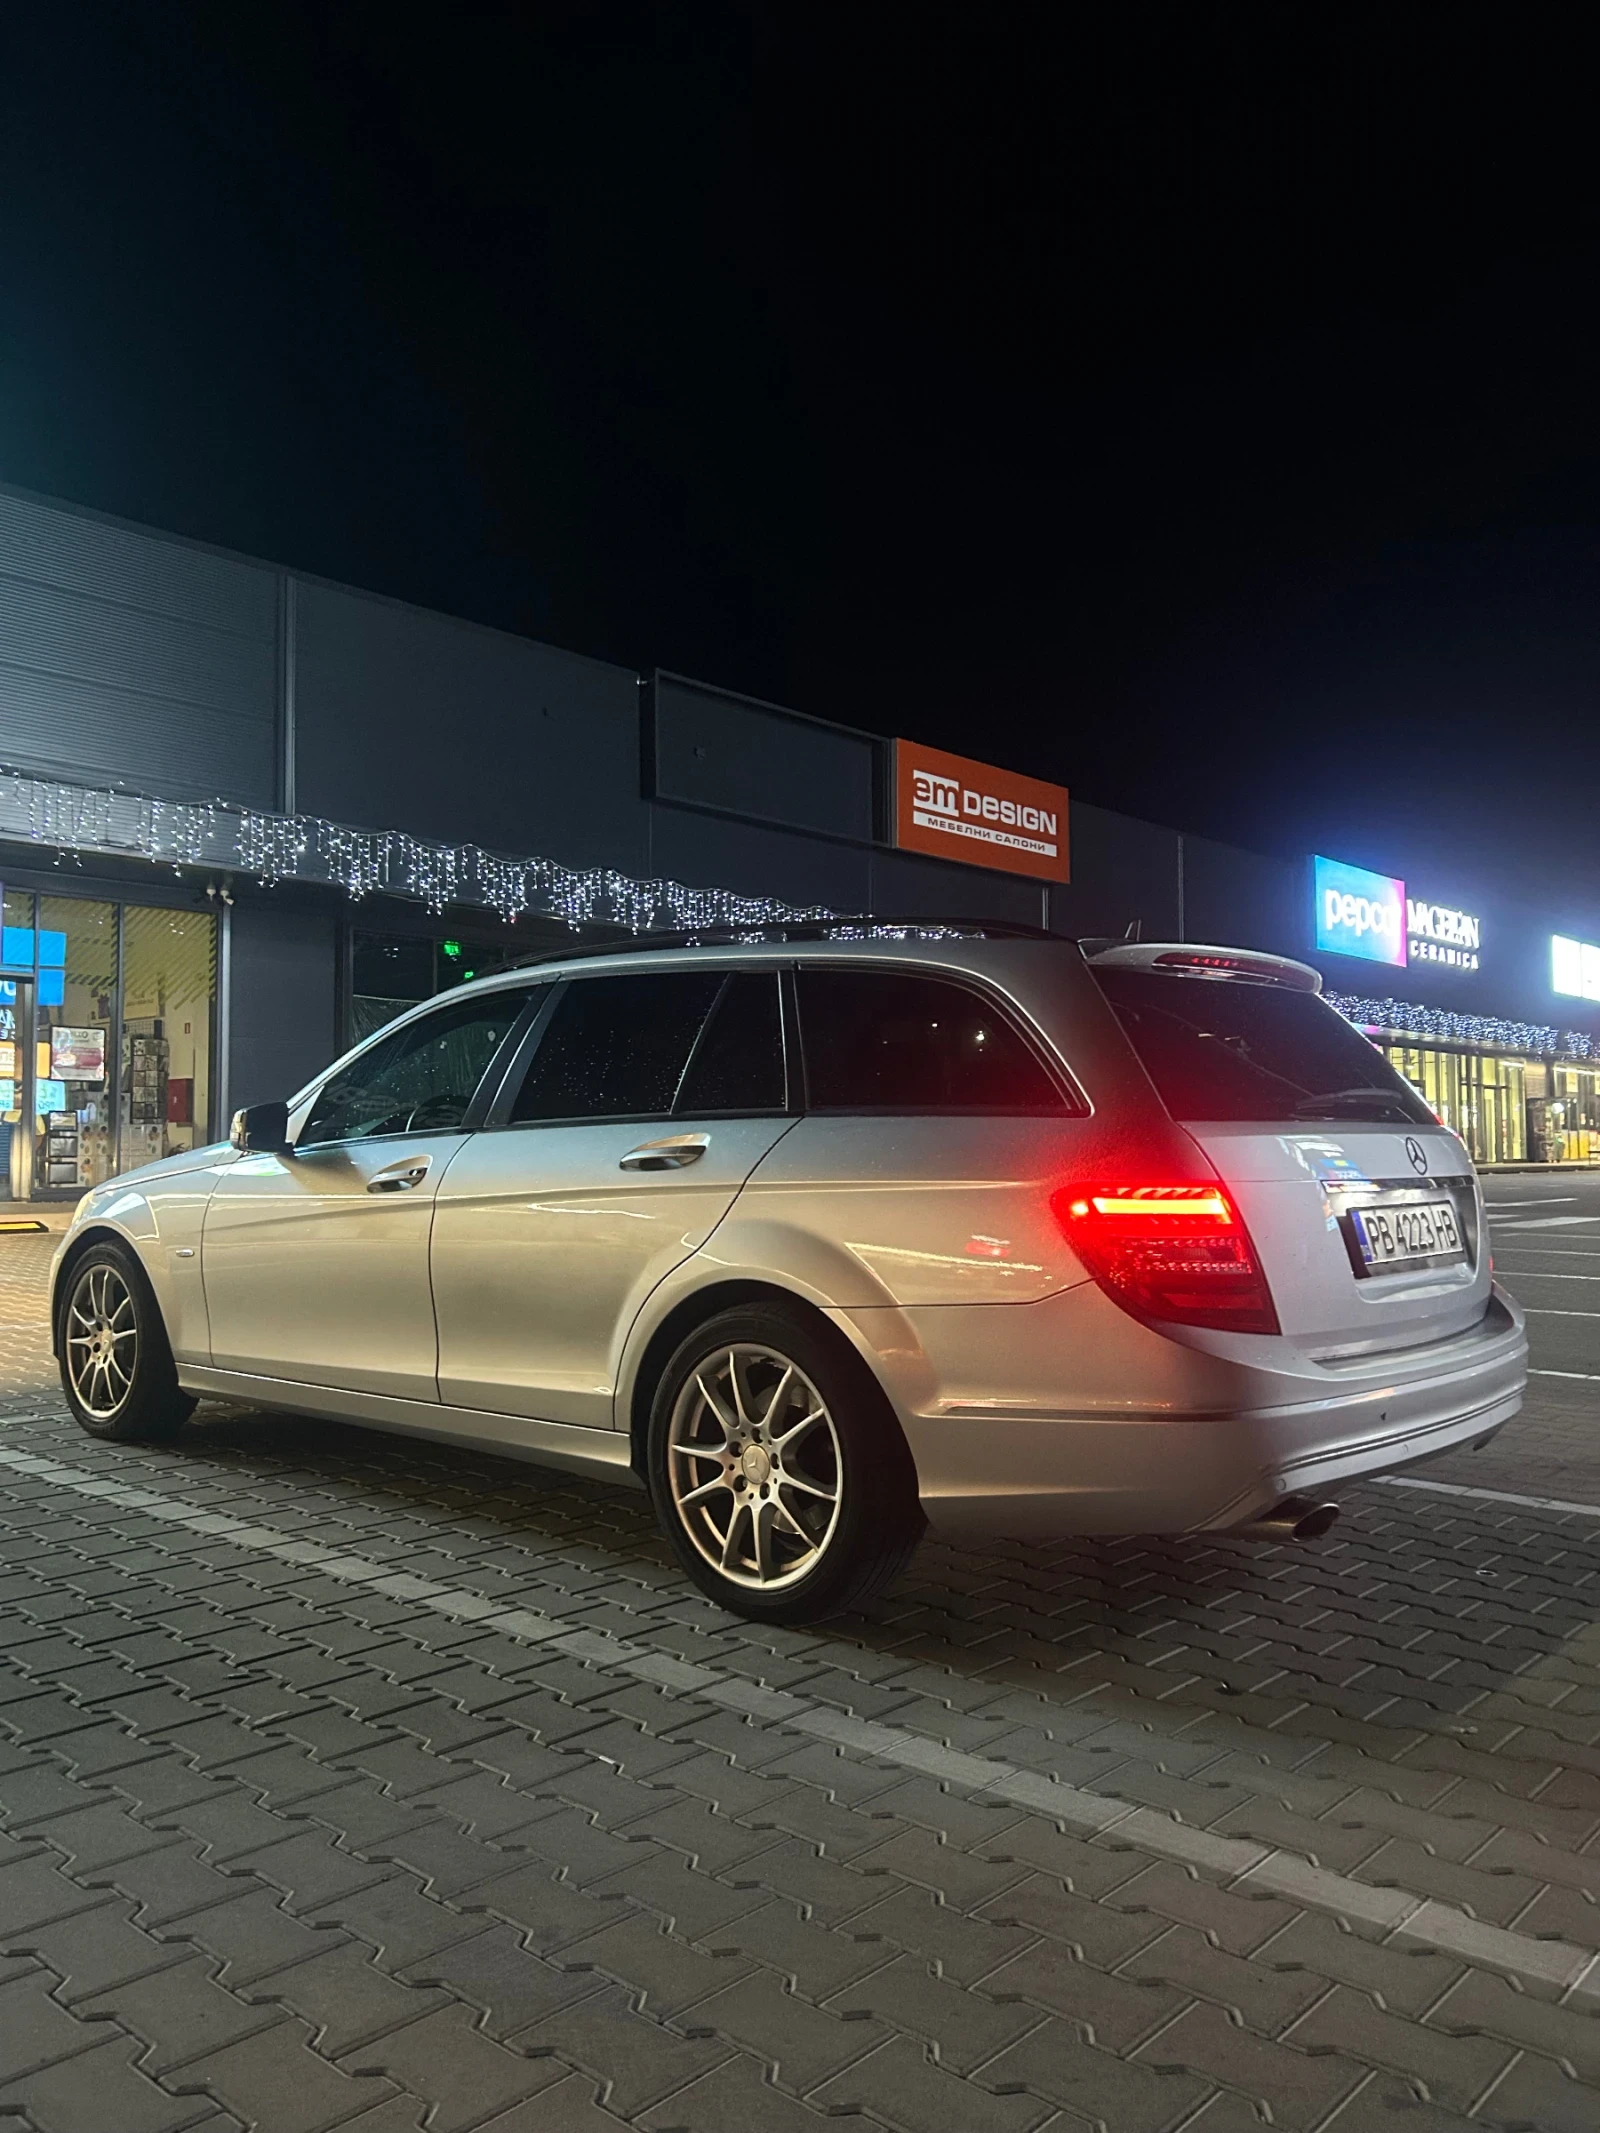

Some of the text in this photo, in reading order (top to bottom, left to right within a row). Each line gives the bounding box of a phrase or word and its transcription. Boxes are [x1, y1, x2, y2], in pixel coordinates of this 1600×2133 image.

[927, 817, 1046, 852] МЕБЕЛНИ САЛОНИ
[1410, 940, 1479, 970] CERAMICA
[1394, 1211, 1435, 1253] 4223
